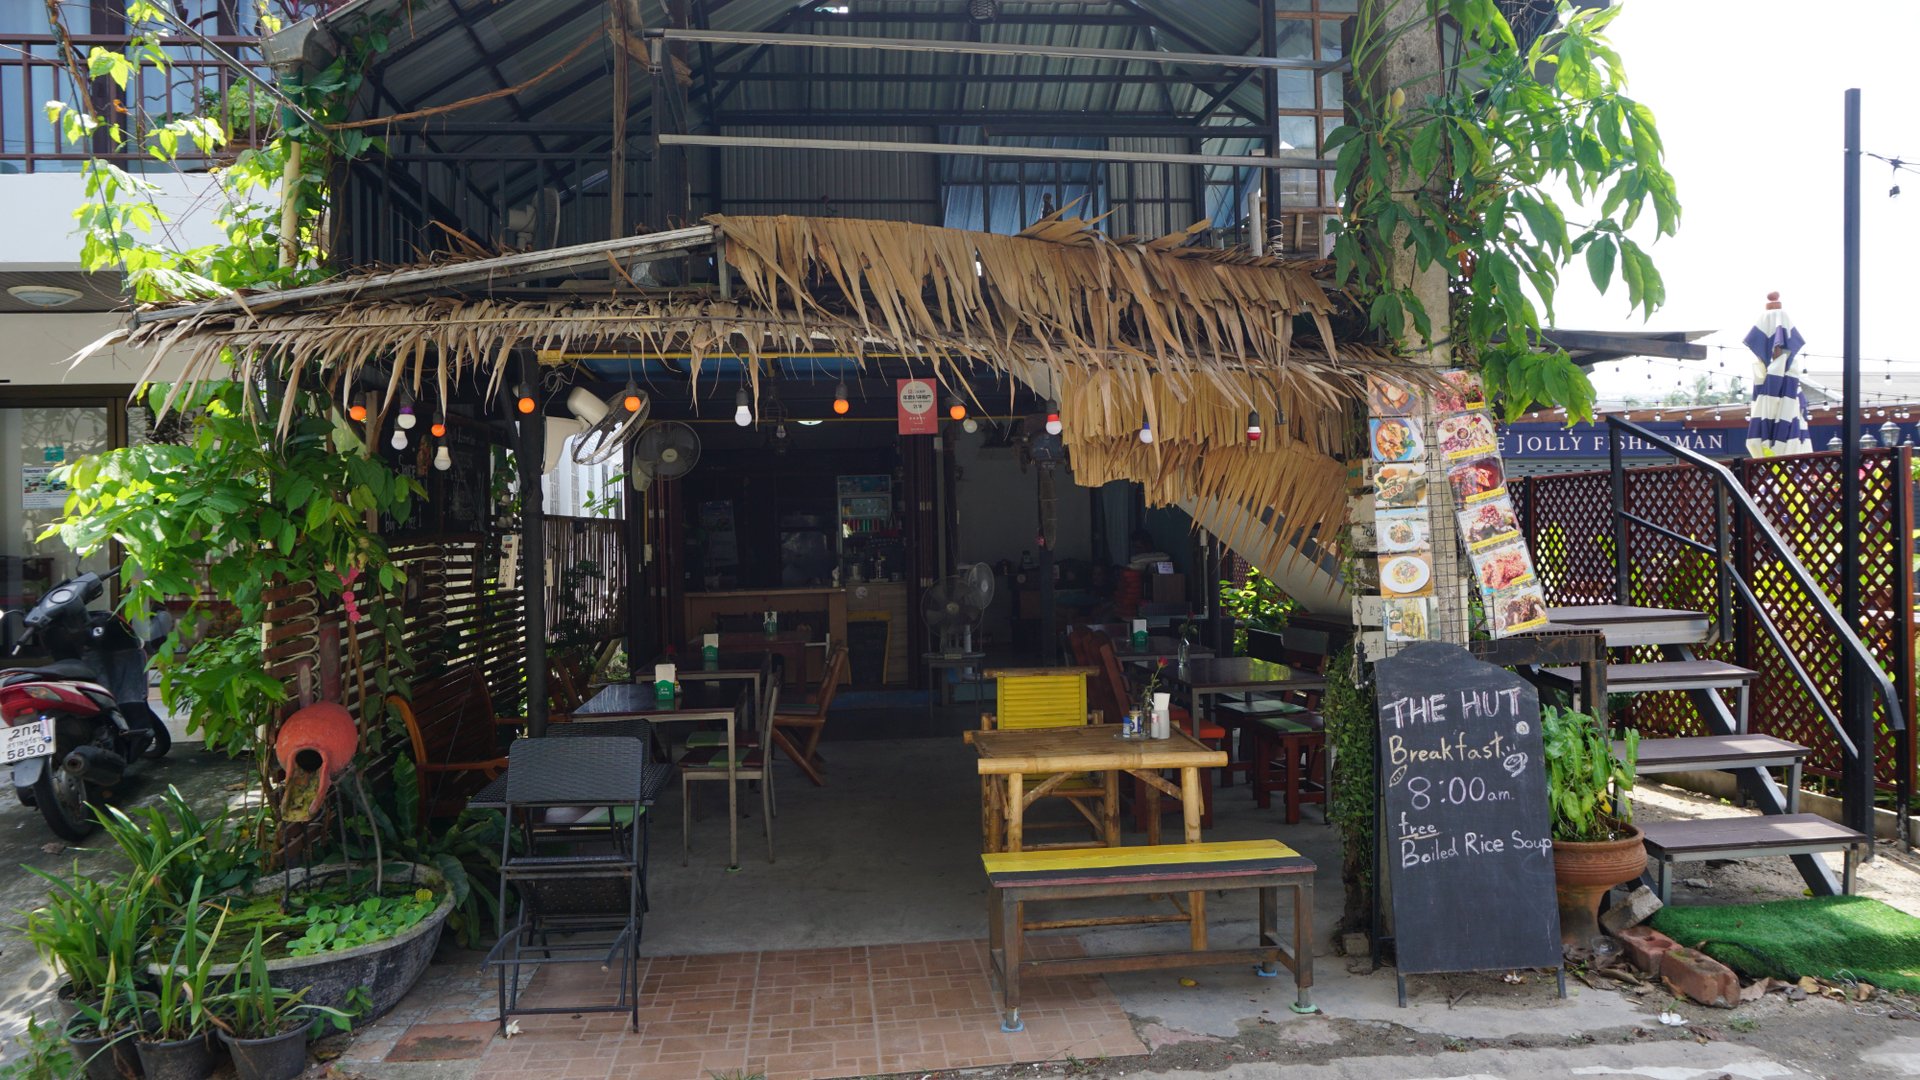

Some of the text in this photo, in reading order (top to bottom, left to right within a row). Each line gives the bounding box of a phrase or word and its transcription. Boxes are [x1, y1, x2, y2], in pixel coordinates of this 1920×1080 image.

[1516, 434, 1582, 454] JOLLY
[1594, 435, 1723, 450] FSHEMAN
[1383, 687, 1521, 728] THE HUT
[7, 743, 46, 760] 5850
[1389, 731, 1503, 764] Breakfast
[1402, 830, 1553, 869] Boiled Rice Soup
